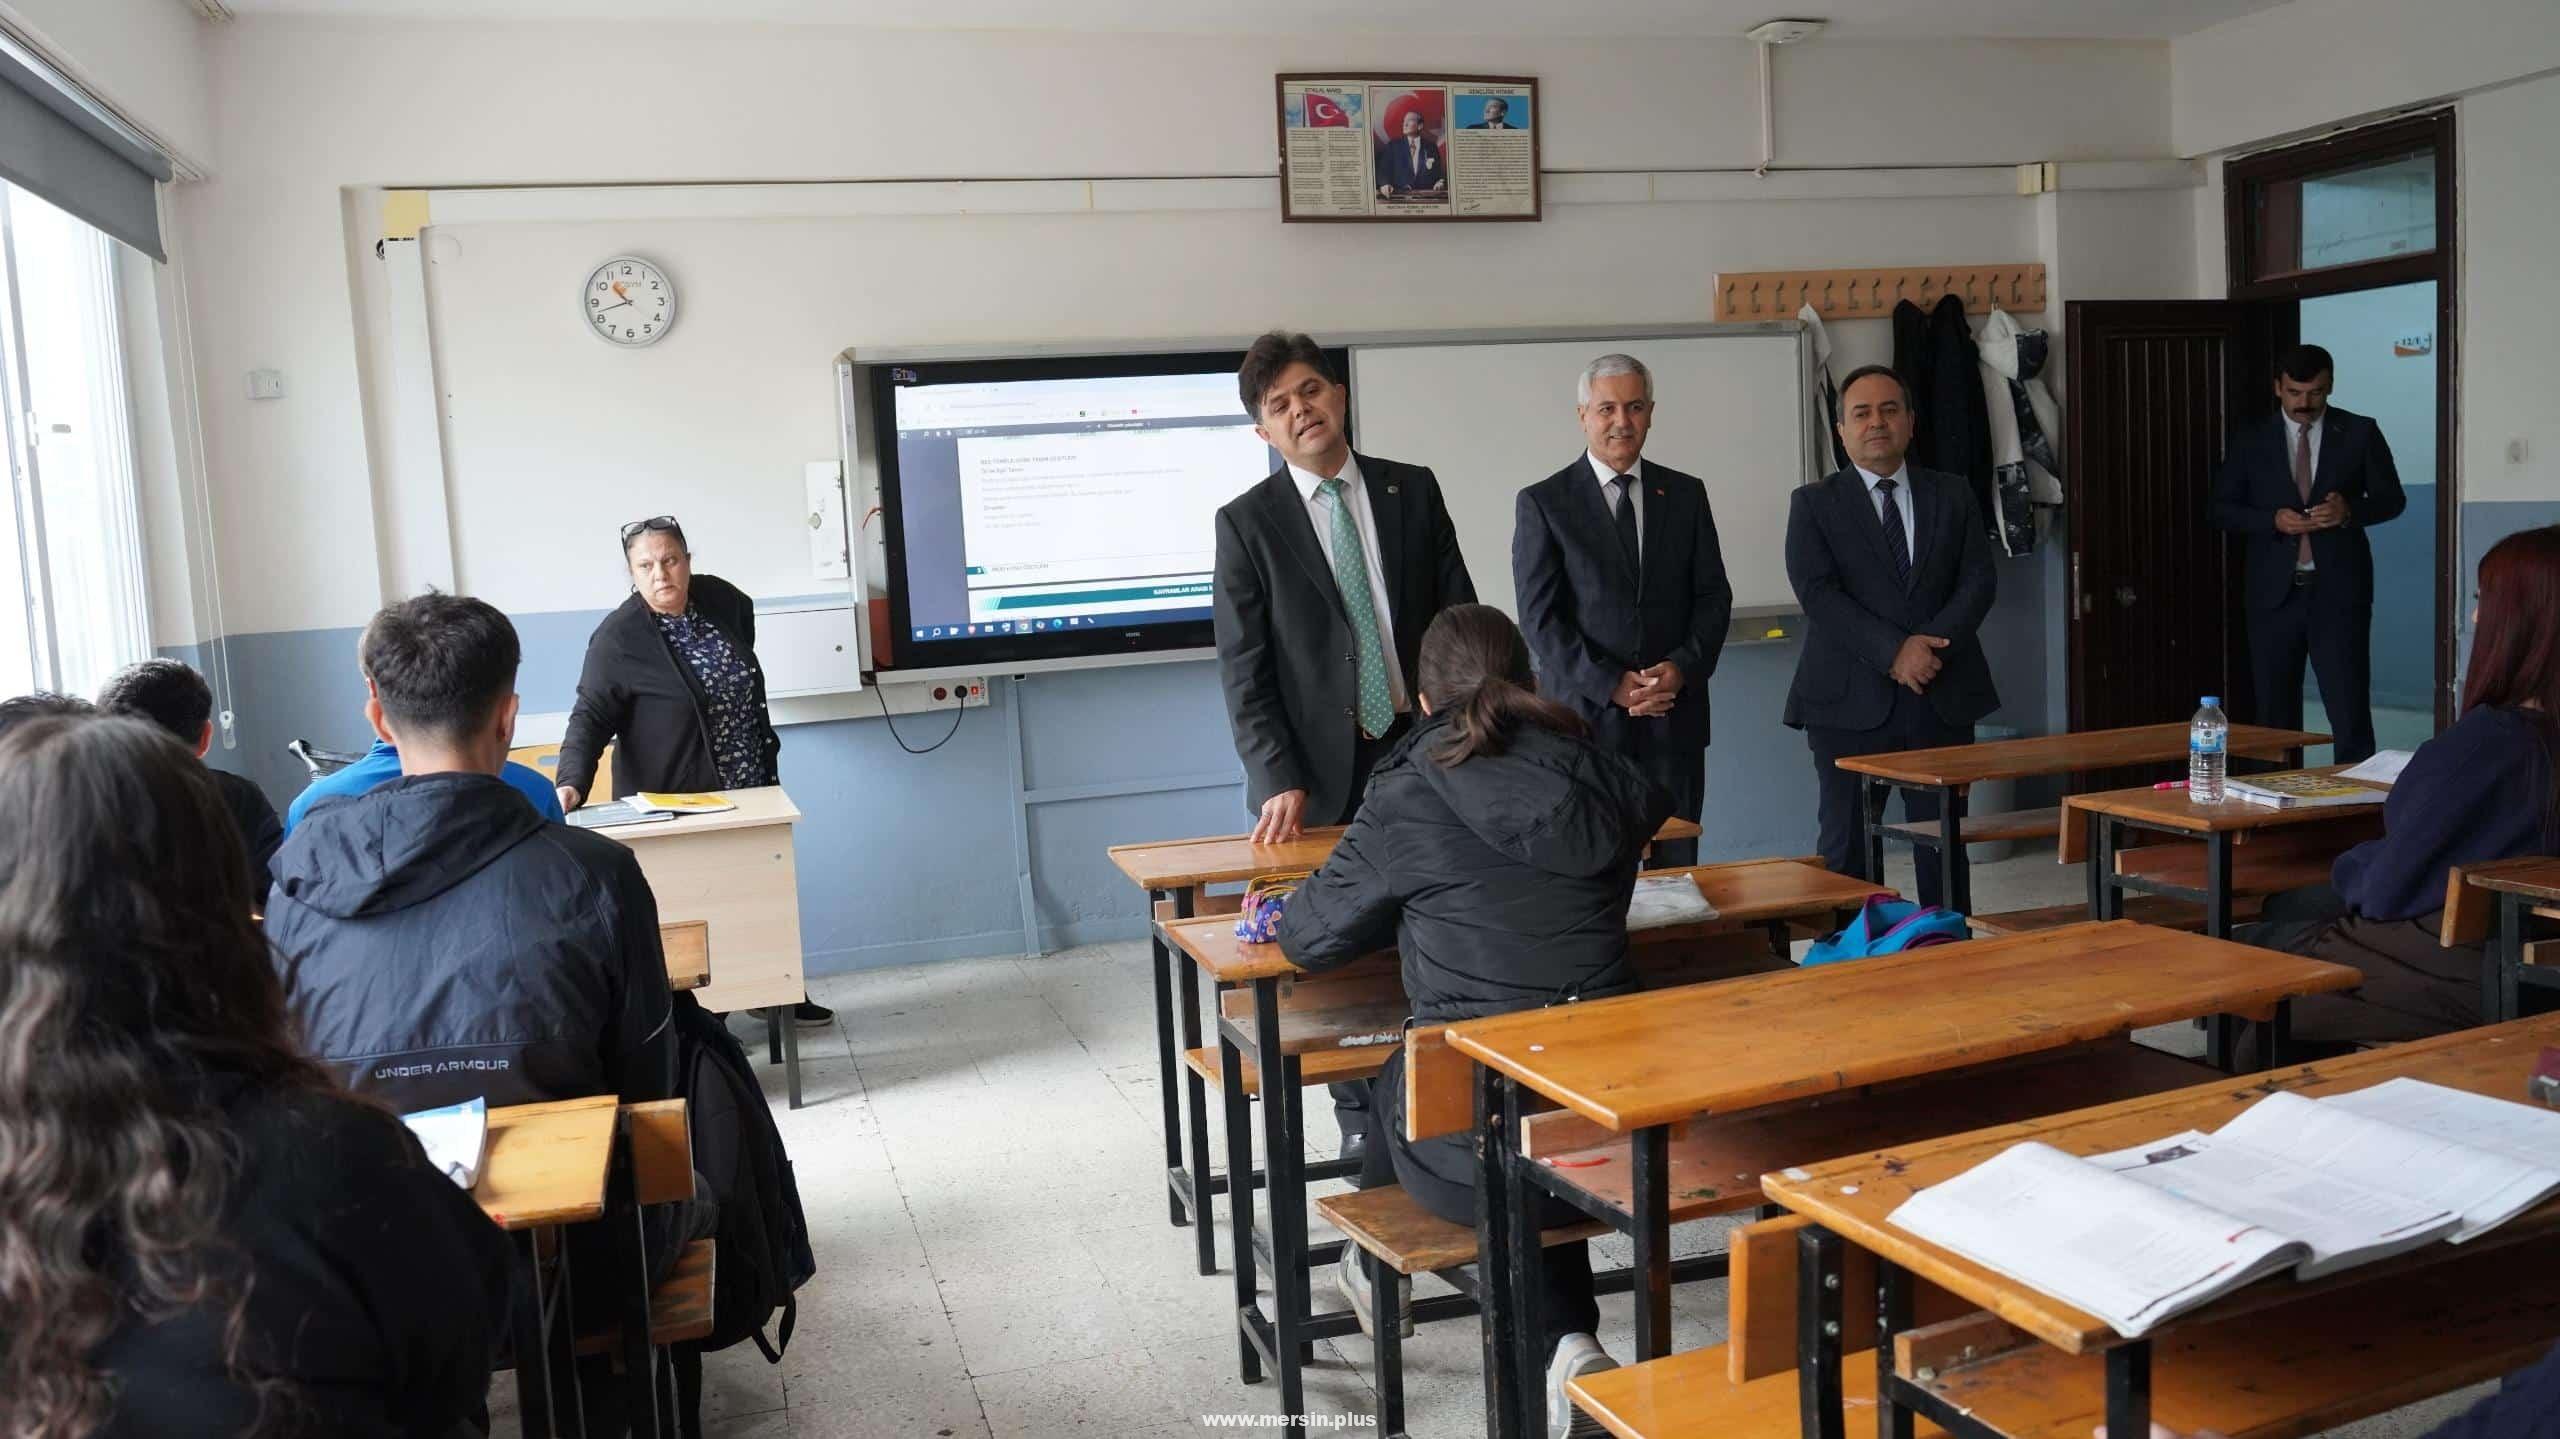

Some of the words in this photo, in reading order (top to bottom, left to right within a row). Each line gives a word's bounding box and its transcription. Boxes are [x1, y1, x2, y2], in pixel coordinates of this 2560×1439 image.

[620, 265, 633, 275] 12
[606, 271, 614, 280] 11
[596, 281, 608, 291] 10
[651, 281, 659, 290] 2
[591, 298, 600, 308] 9
[657, 297, 665, 306] 3
[597, 314, 606, 323] 8
[654, 313, 661, 322] 4
[608, 325, 617, 334] 7
[643, 324, 652, 333] 5
[626, 329, 635, 338] 6
[376, 1064, 432, 1079] UNDER
[436, 1059, 510, 1073] ARMOUR
